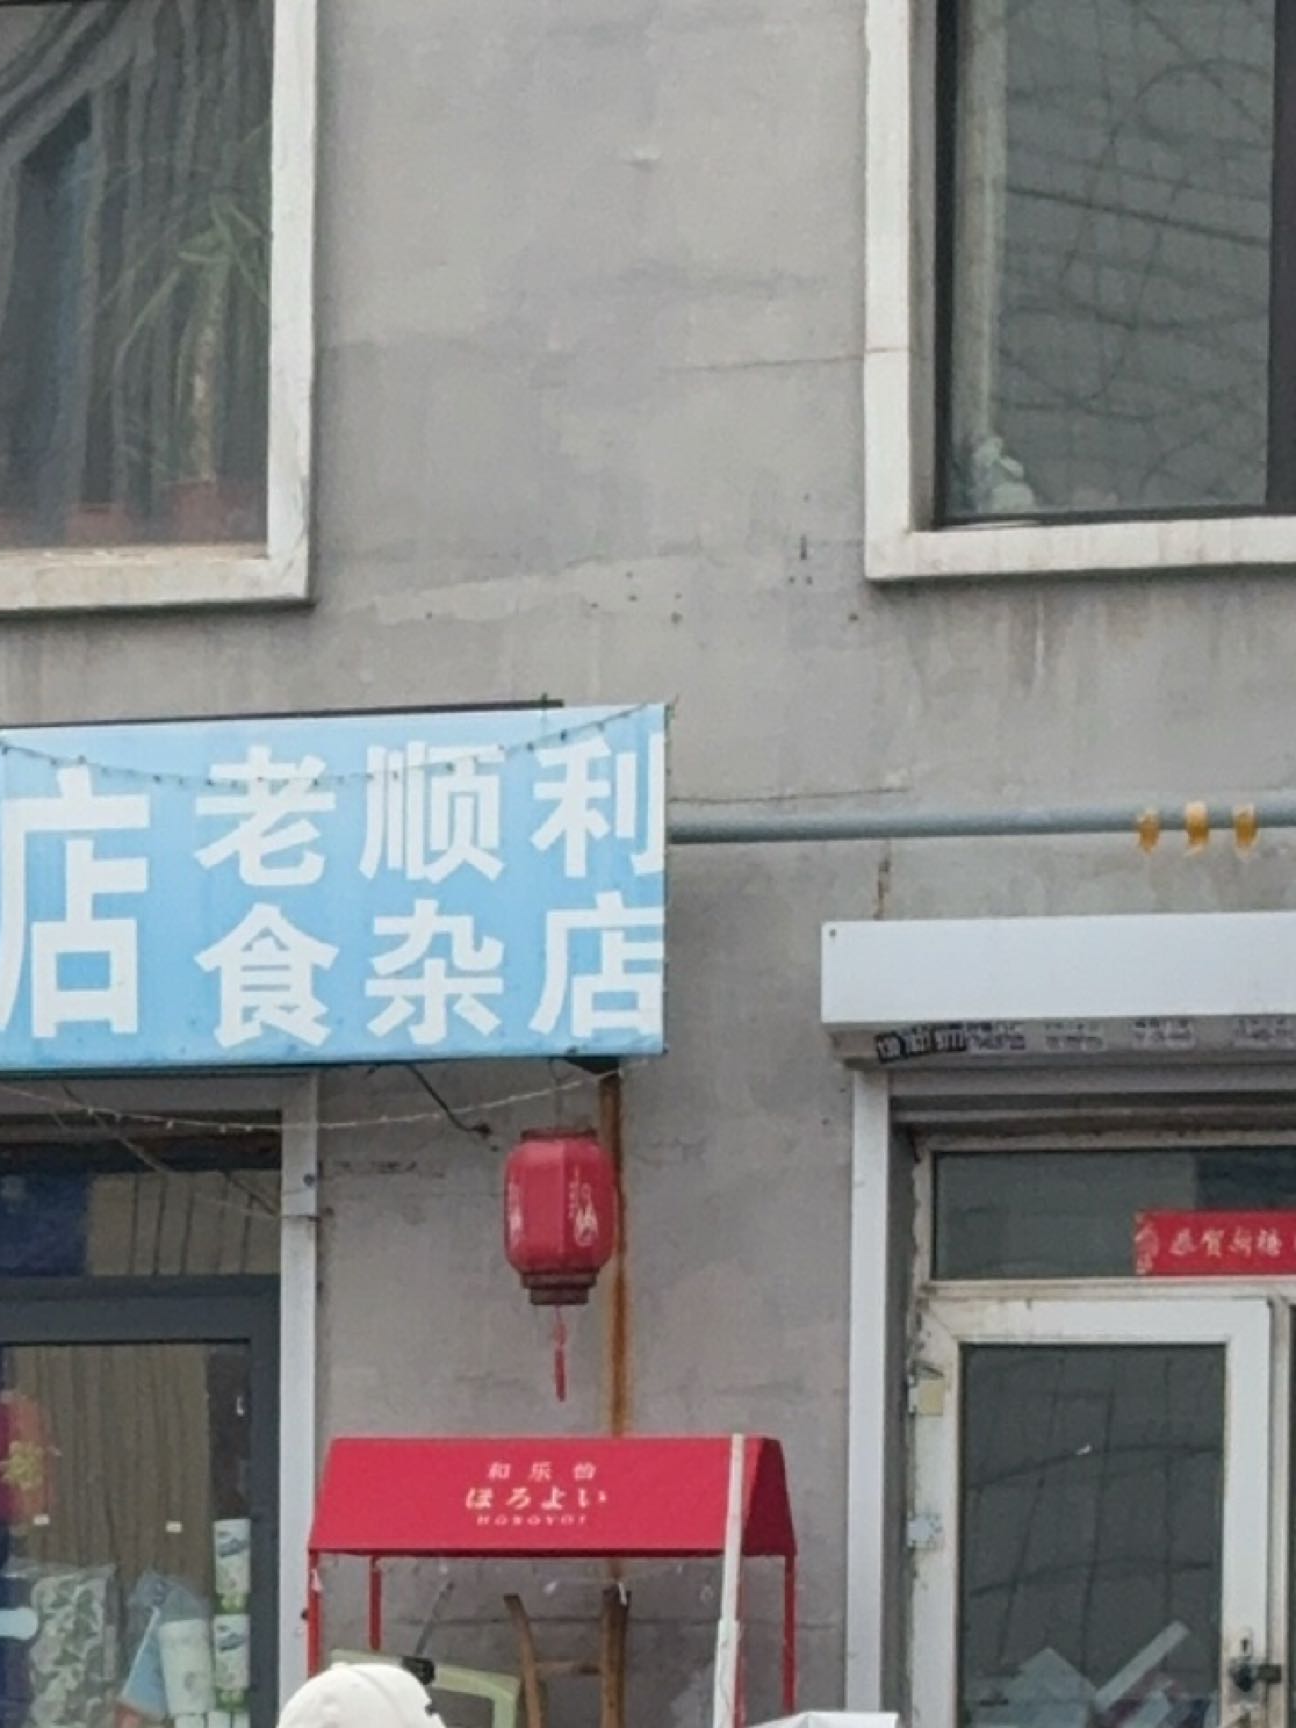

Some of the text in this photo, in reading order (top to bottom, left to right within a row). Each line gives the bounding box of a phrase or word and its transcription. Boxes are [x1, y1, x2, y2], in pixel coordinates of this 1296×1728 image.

[194, 731, 665, 886] 老顺利
[194, 891, 665, 1050] 食杂店
[465, 1484, 607, 1511] ほろよい
